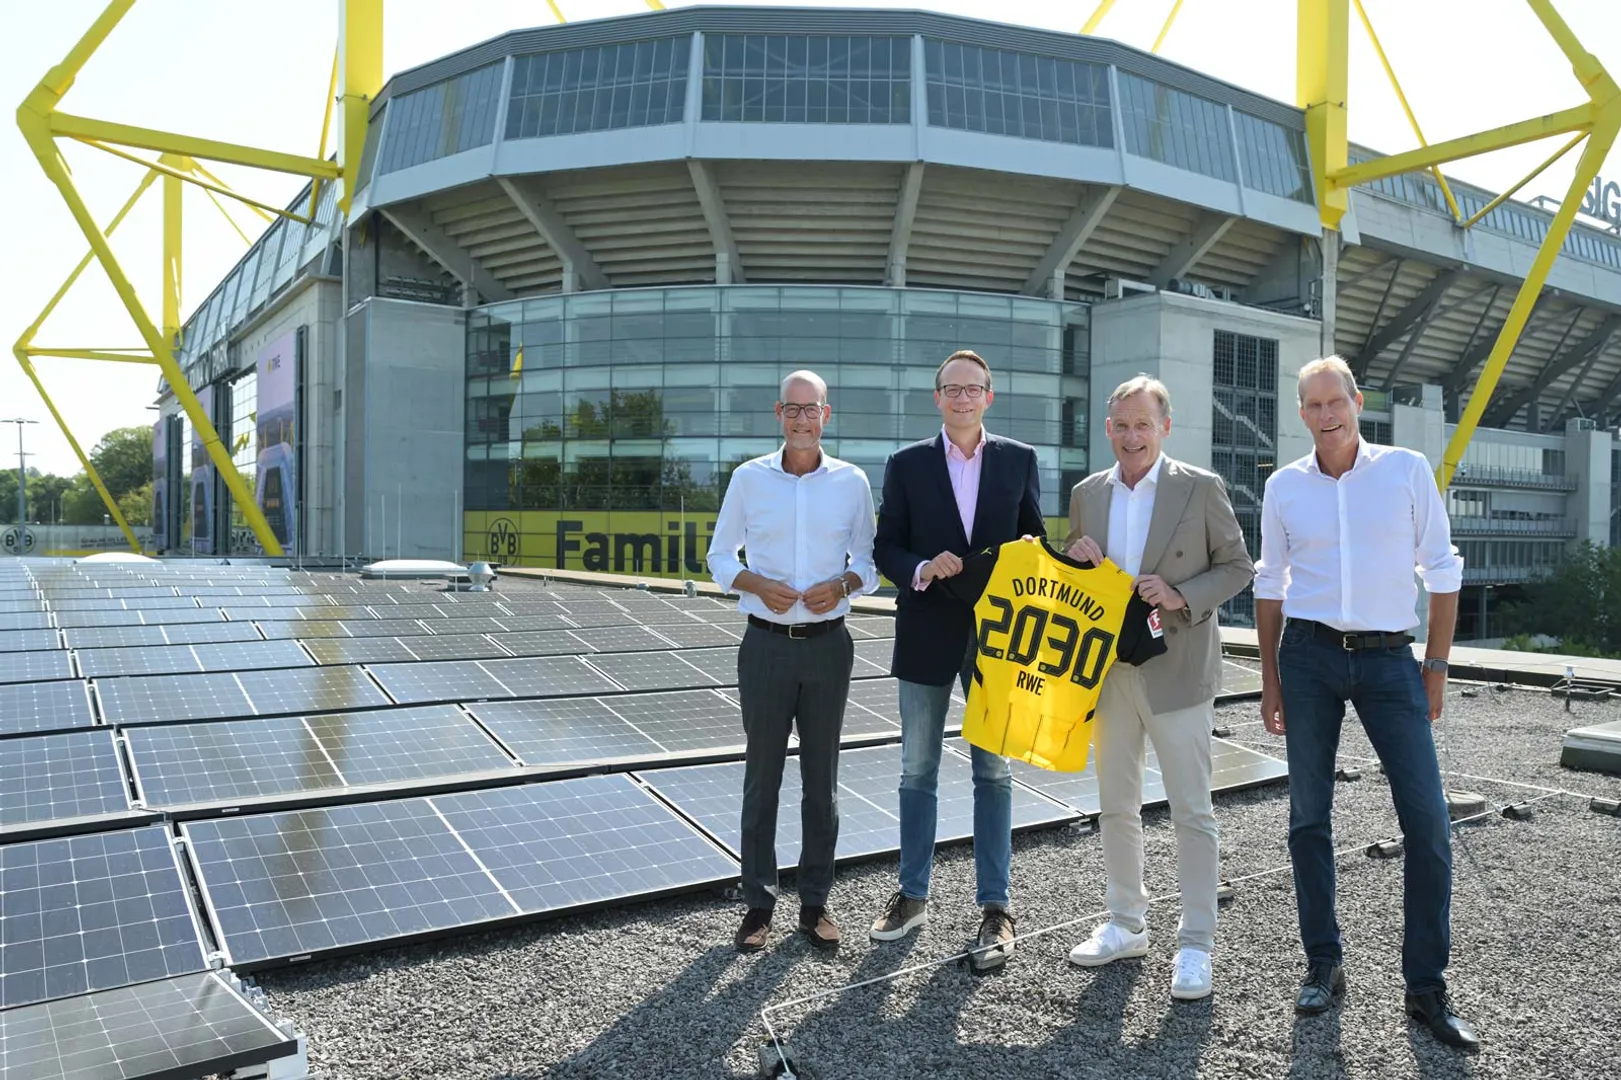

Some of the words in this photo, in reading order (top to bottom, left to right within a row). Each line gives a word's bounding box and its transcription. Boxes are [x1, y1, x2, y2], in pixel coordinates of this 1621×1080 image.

[490, 522, 517, 554] BVB
[1012, 578, 1105, 621] DORTMUND
[979, 594, 1115, 690] 2030
[1016, 670, 1046, 696] RWE
